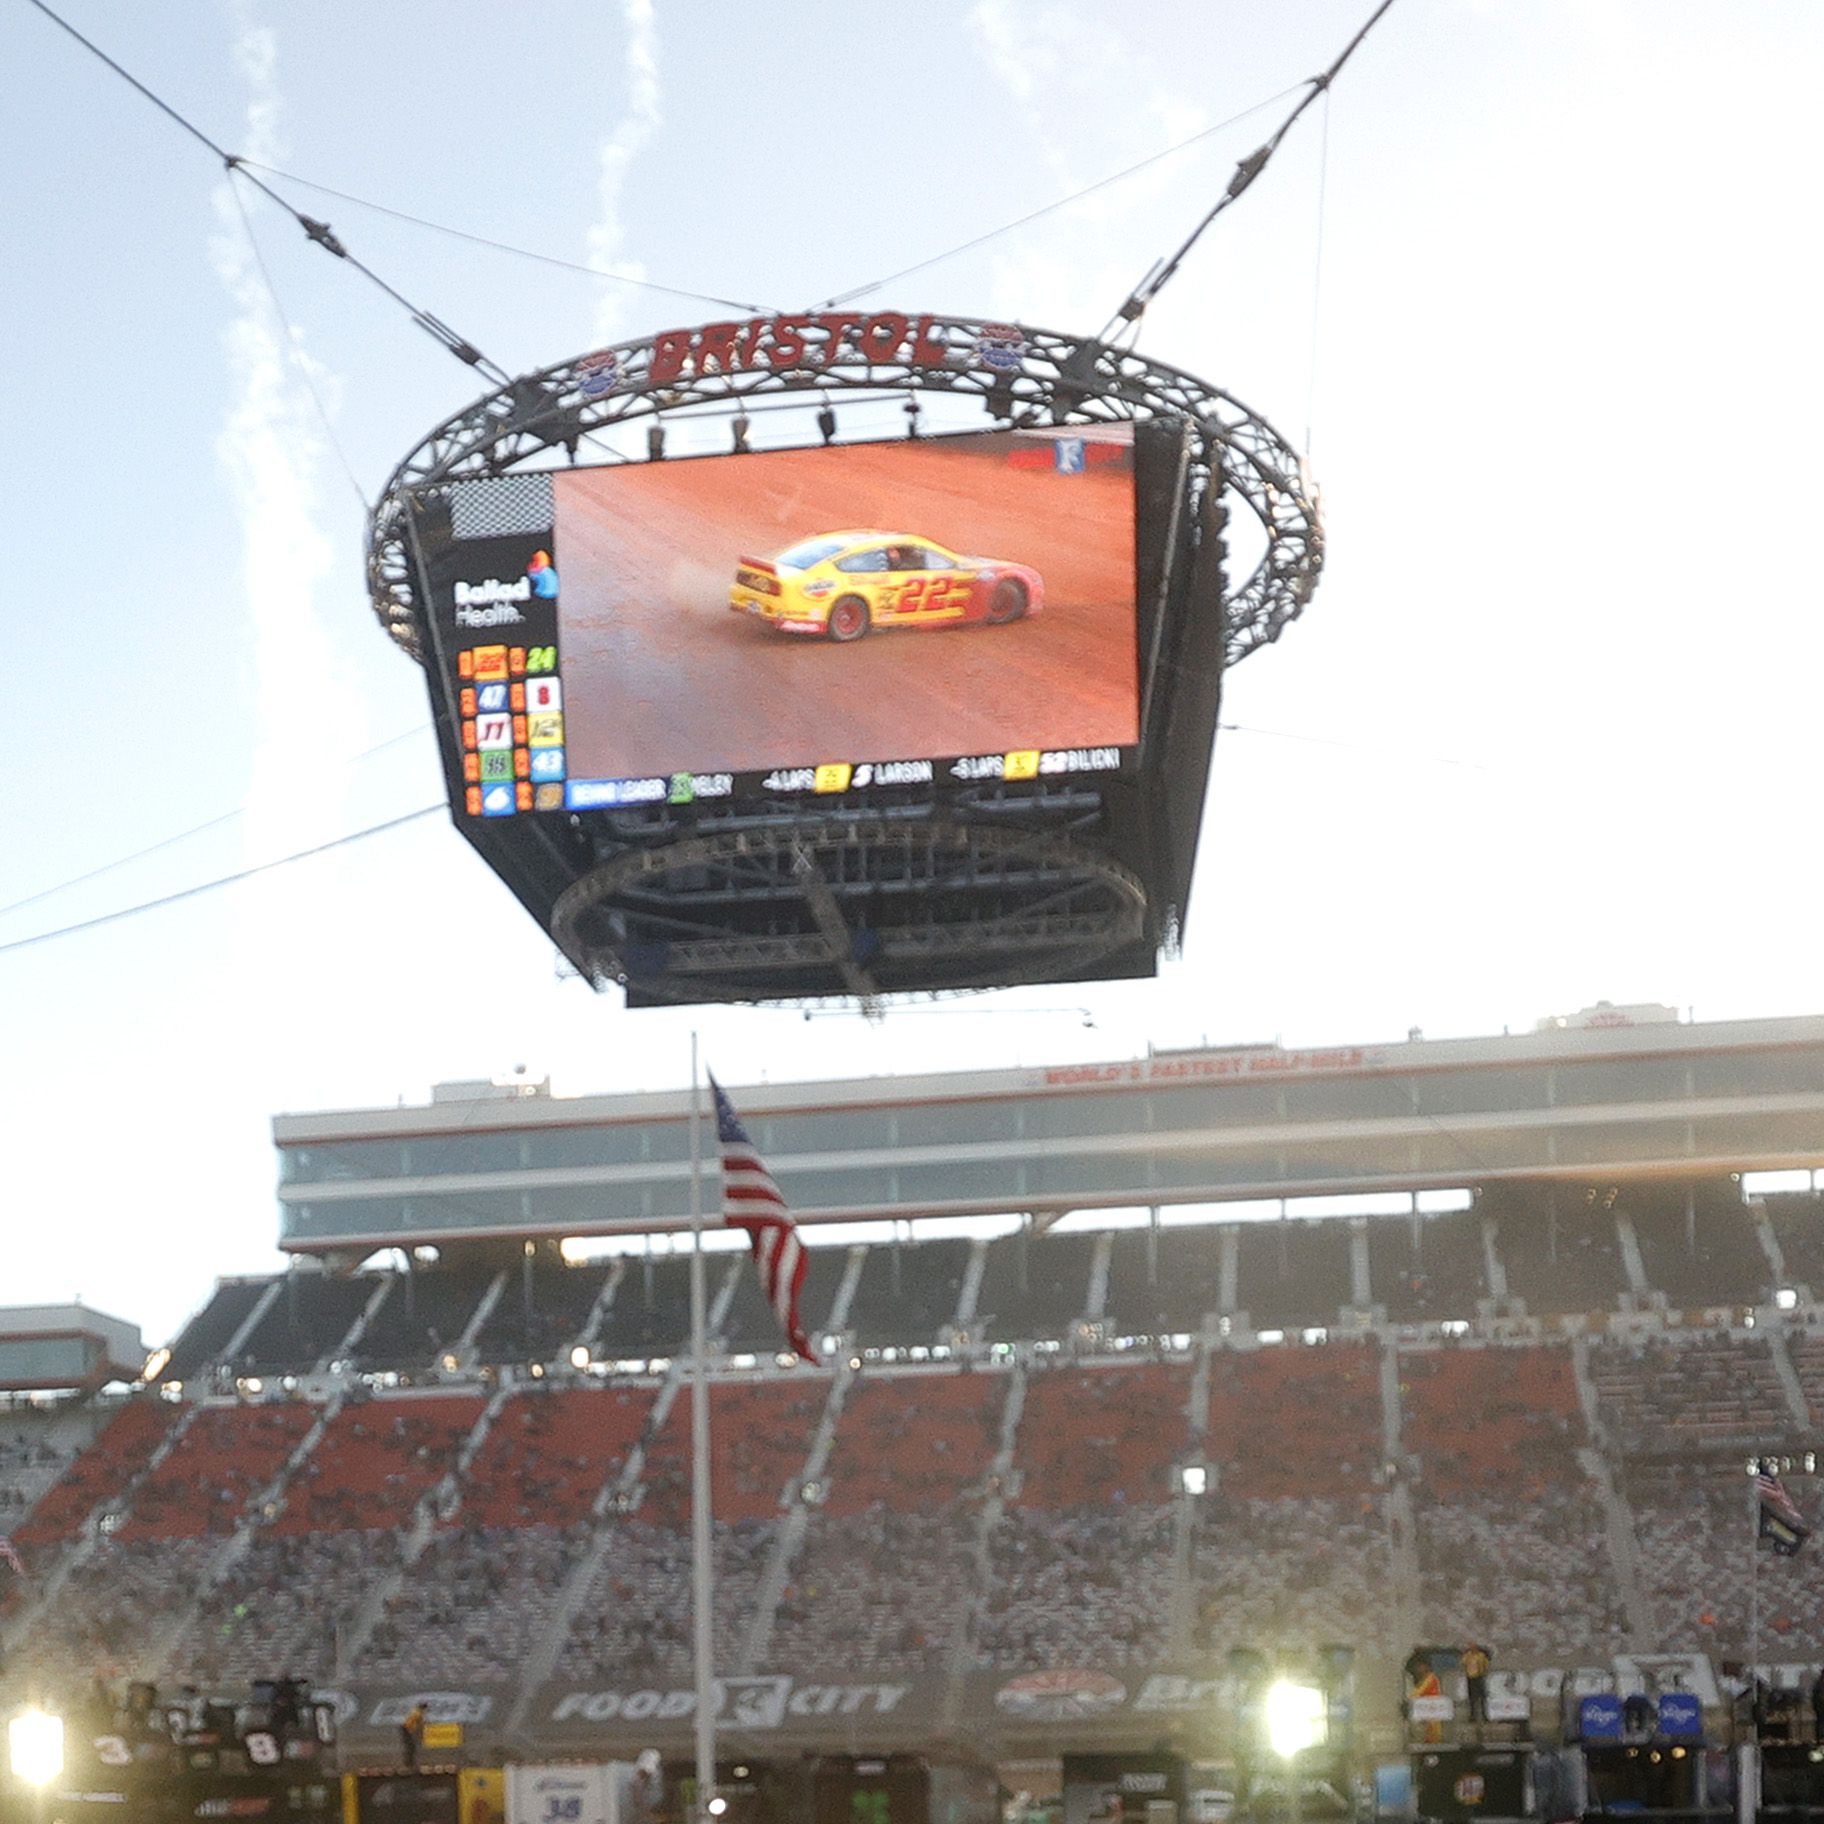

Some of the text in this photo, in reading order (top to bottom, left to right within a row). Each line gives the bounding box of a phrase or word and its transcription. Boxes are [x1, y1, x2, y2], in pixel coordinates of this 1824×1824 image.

[649, 311, 947, 384] BRISTOL
[895, 576, 953, 613] 22
[527, 646, 557, 673] 24
[537, 686, 551, 705] 8
[851, 760, 934, 788] 5 LARSON
[787, 1682, 912, 1715] CITY
